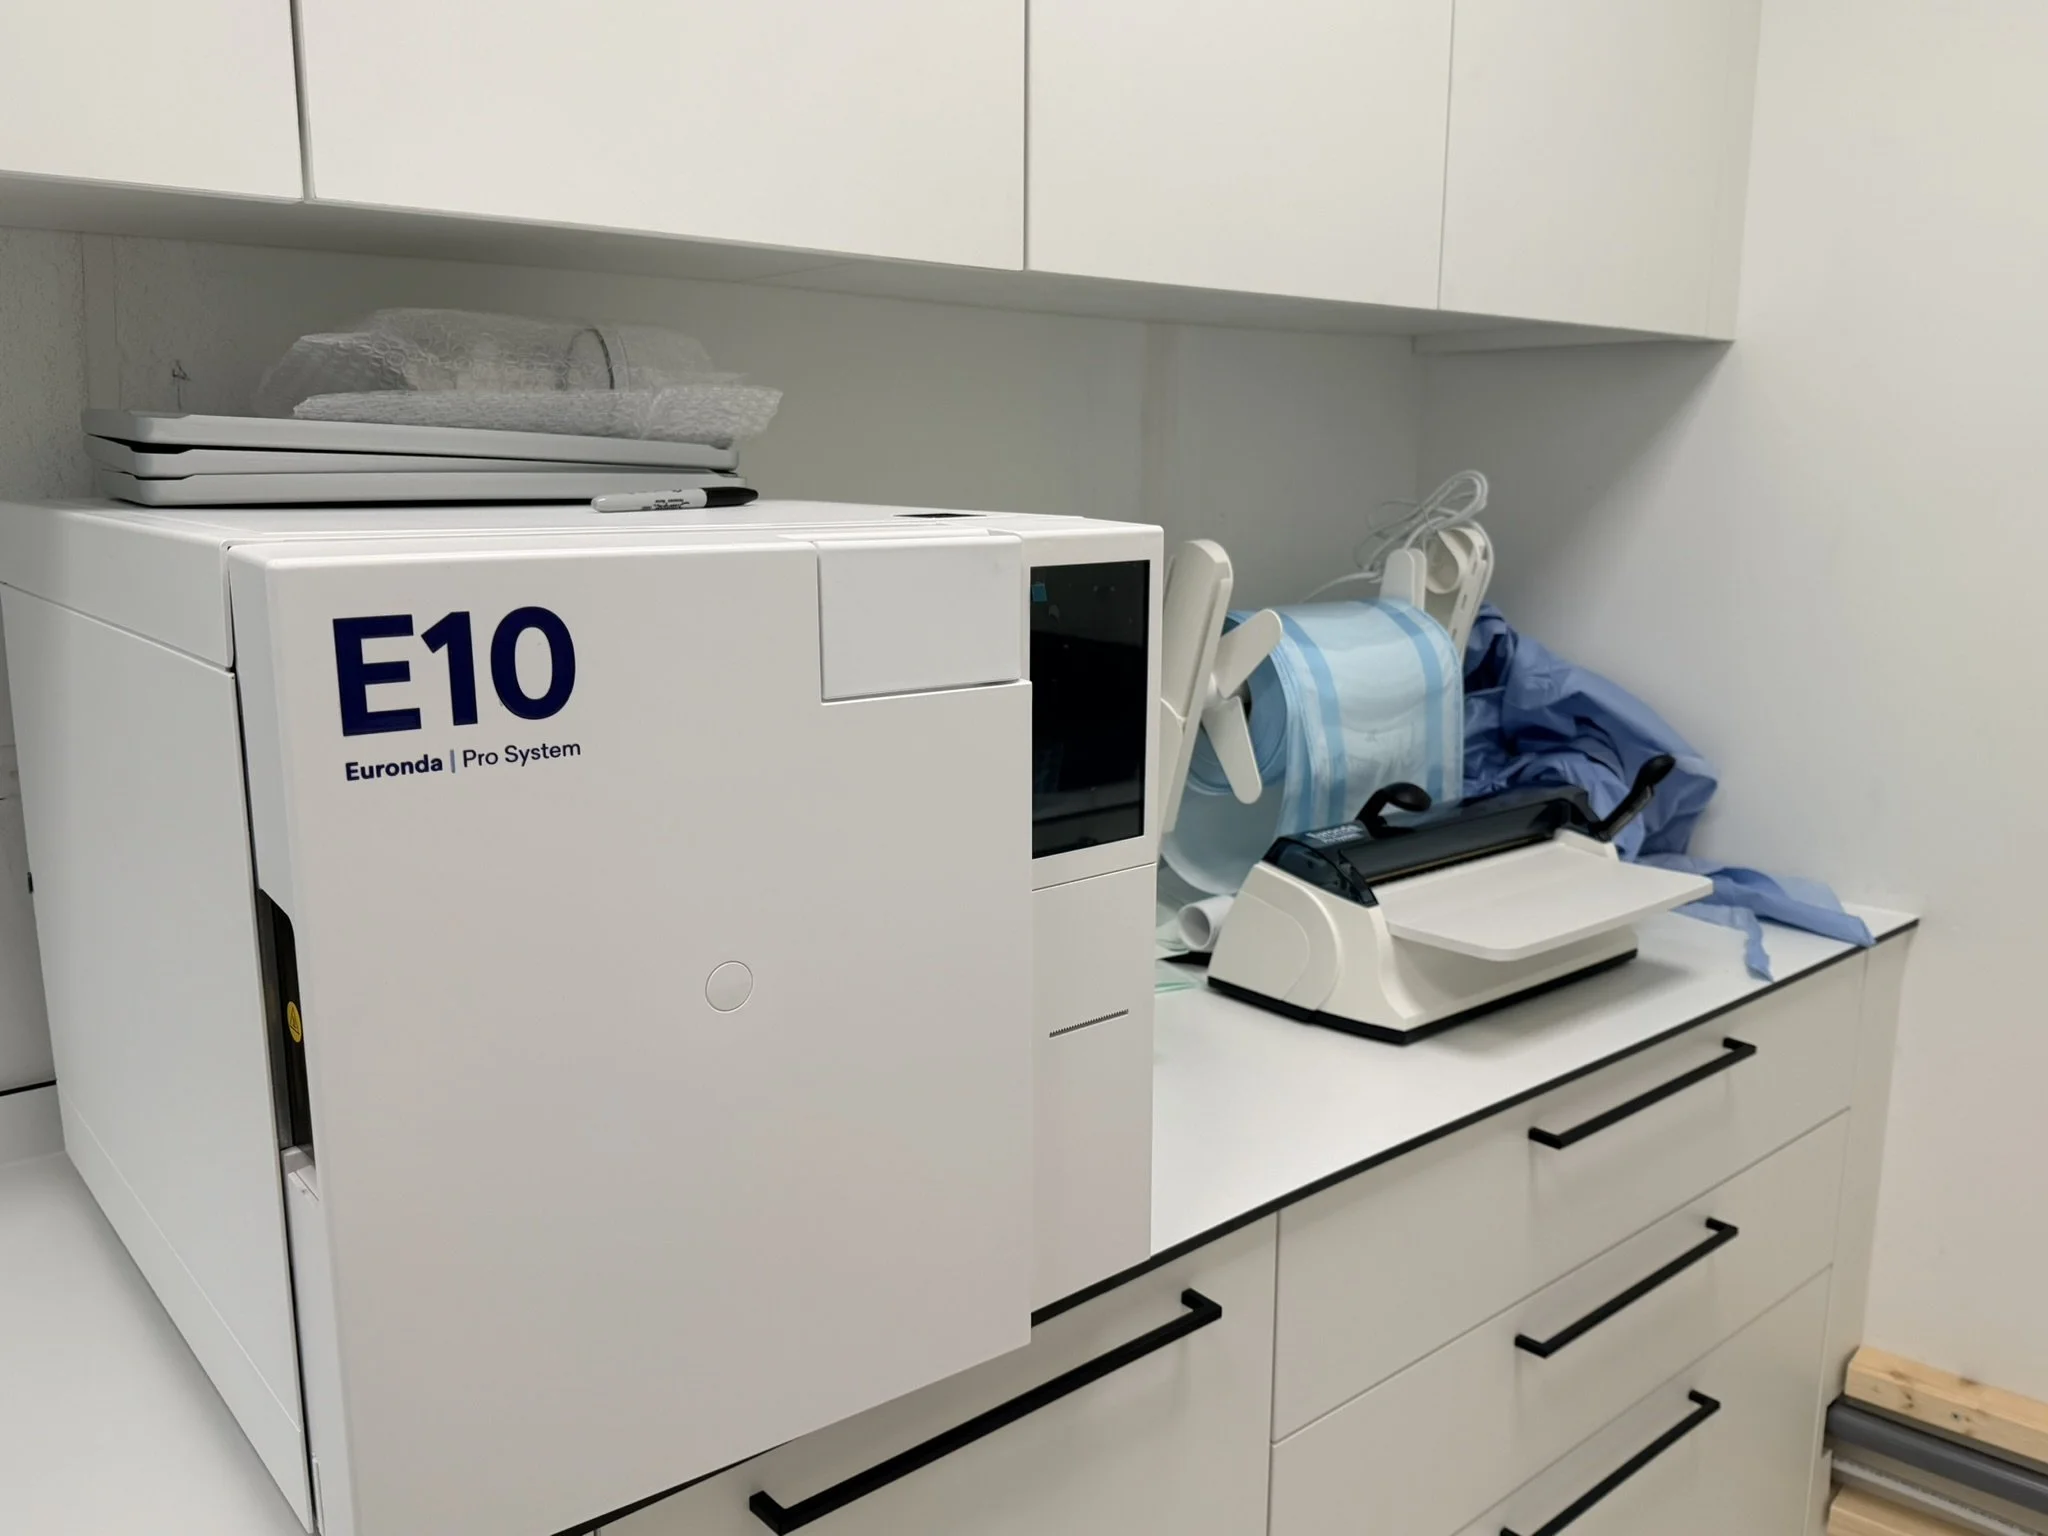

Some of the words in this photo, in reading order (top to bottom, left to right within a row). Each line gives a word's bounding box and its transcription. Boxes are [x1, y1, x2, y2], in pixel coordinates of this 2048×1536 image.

[333, 606, 576, 736] E10
[345, 754, 443, 781] Euronda
[462, 749, 499, 767] Pro
[504, 743, 581, 767] System
